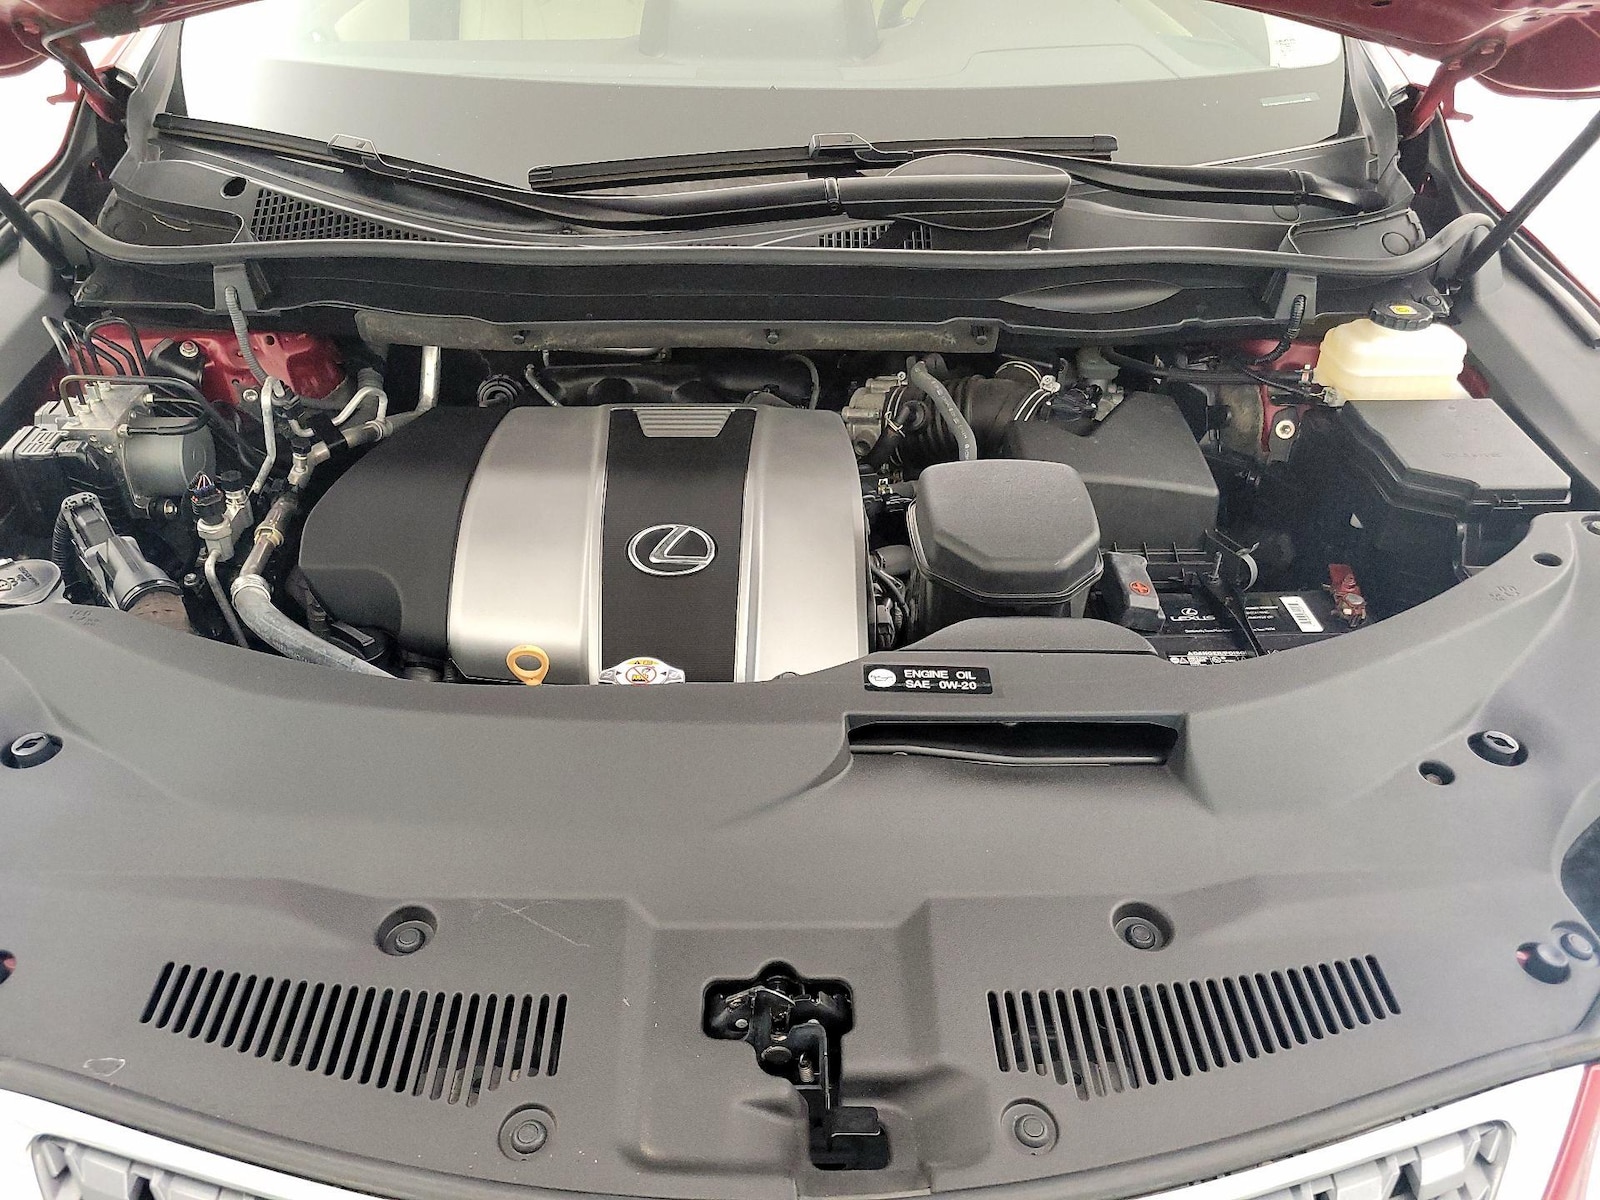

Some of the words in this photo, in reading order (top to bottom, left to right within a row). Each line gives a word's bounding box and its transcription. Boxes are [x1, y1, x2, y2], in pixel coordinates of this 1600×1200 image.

[904, 669, 949, 679] ENGINE
[956, 670, 977, 680] OIL
[905, 680, 931, 689] SAE
[939, 680, 977, 690] 0W-20
